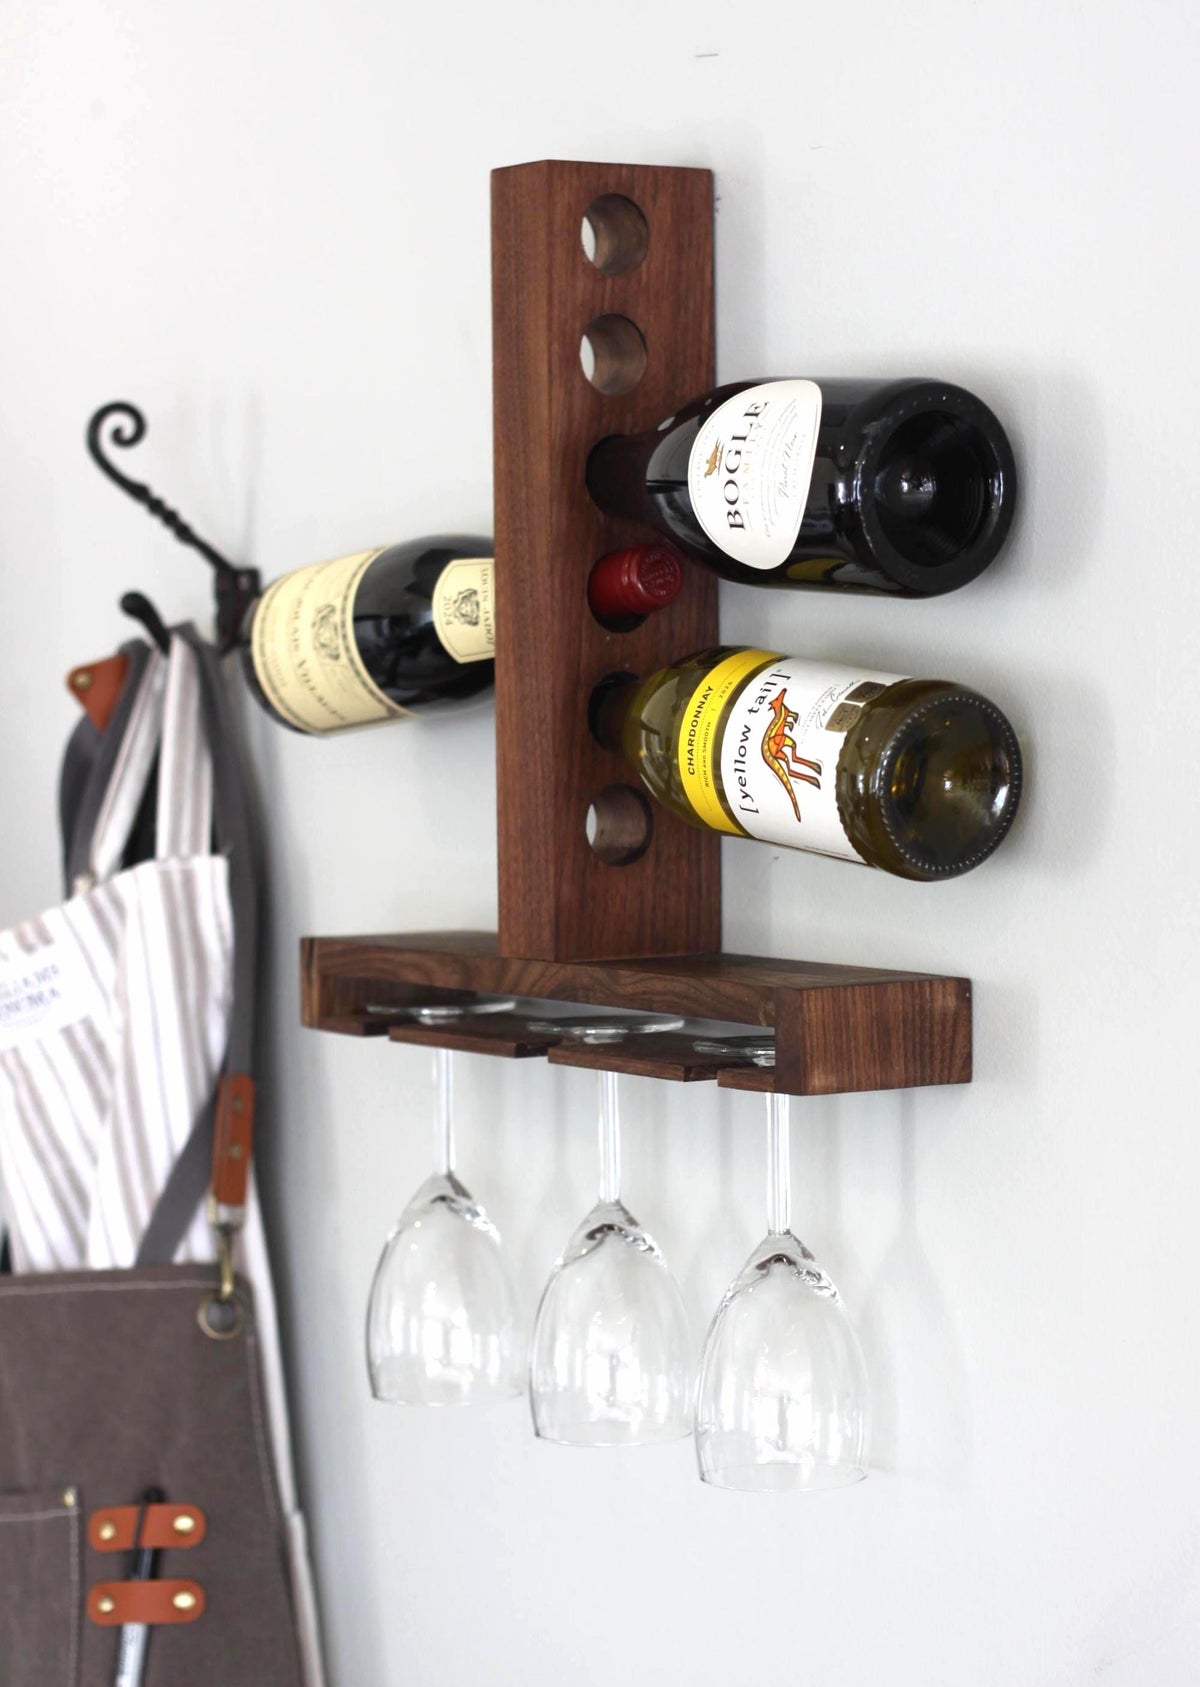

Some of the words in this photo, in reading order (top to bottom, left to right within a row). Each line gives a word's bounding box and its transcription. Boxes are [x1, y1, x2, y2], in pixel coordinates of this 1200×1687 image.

[724, 400, 770, 531] BOGLE
[743, 422, 763, 505] FAMILY
[687, 685, 714, 776] CHARDONNAY
[702, 721, 712, 754] SMOOTH
[703, 772, 711, 788] RICH
